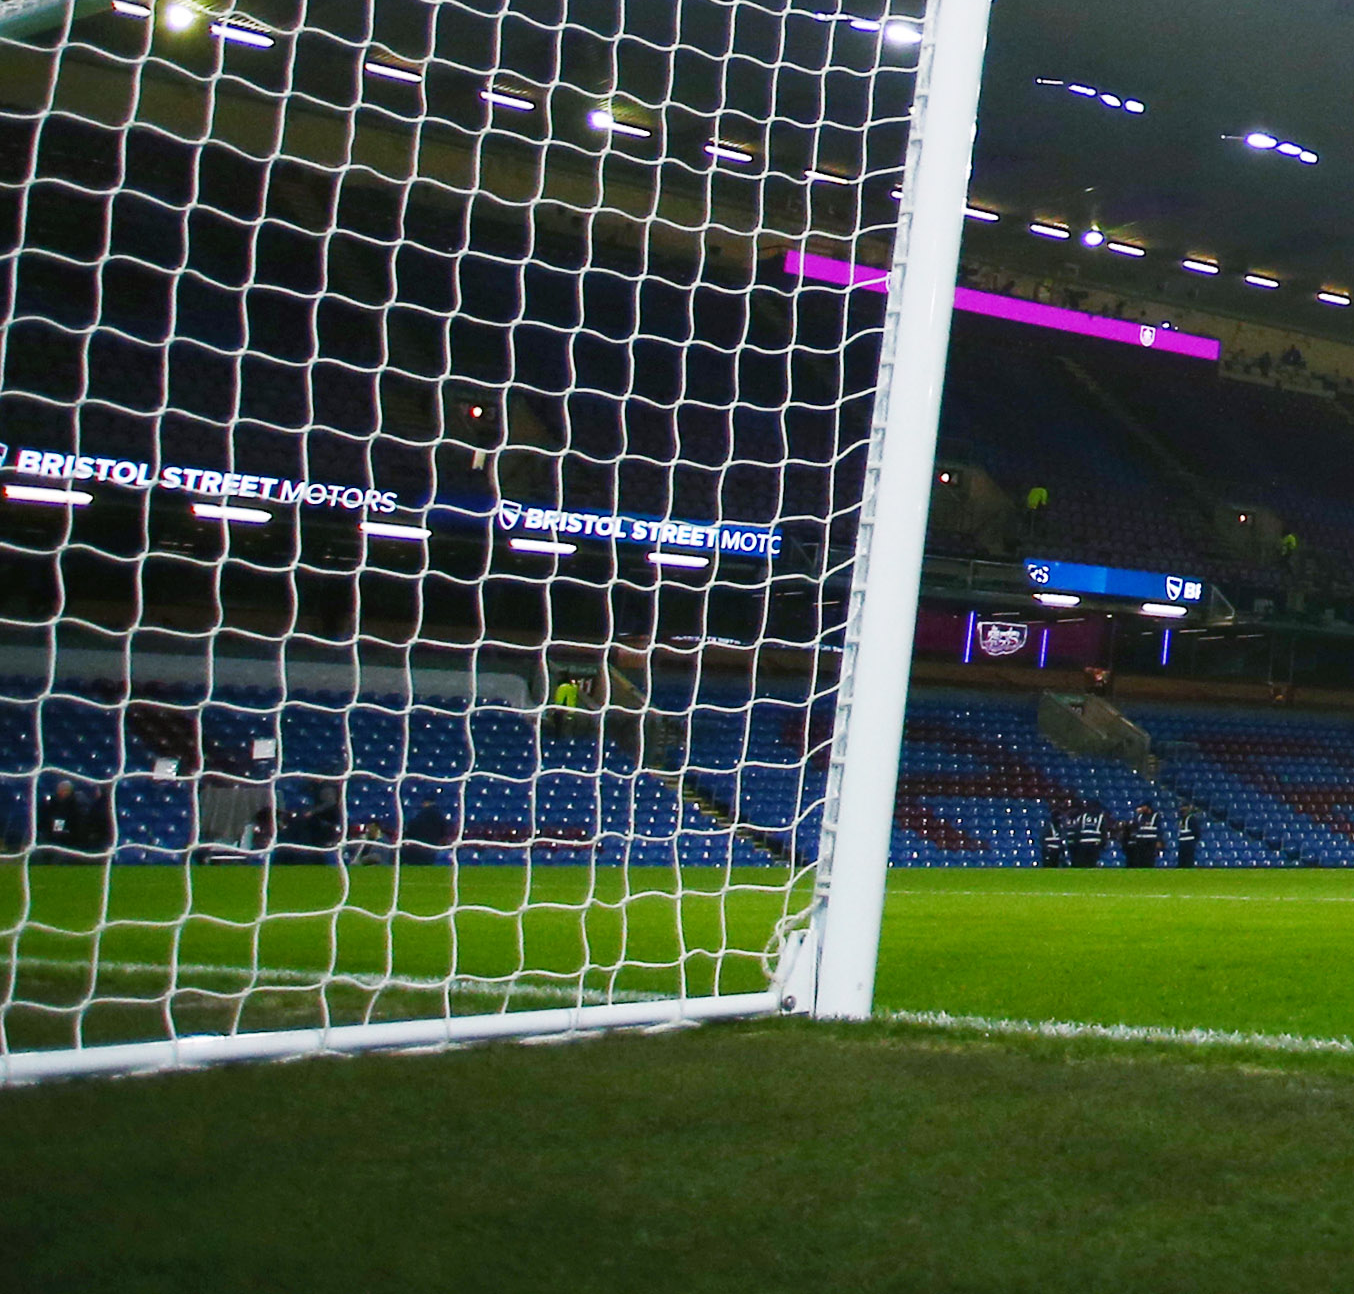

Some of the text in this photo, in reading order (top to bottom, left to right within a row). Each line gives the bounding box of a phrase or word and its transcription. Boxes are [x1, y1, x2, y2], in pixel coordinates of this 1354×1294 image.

[16, 449, 399, 514] BRISTOL STREET MOTORS
[524, 508, 626, 539] BRISTOL
[631, 521, 719, 548] STREET
